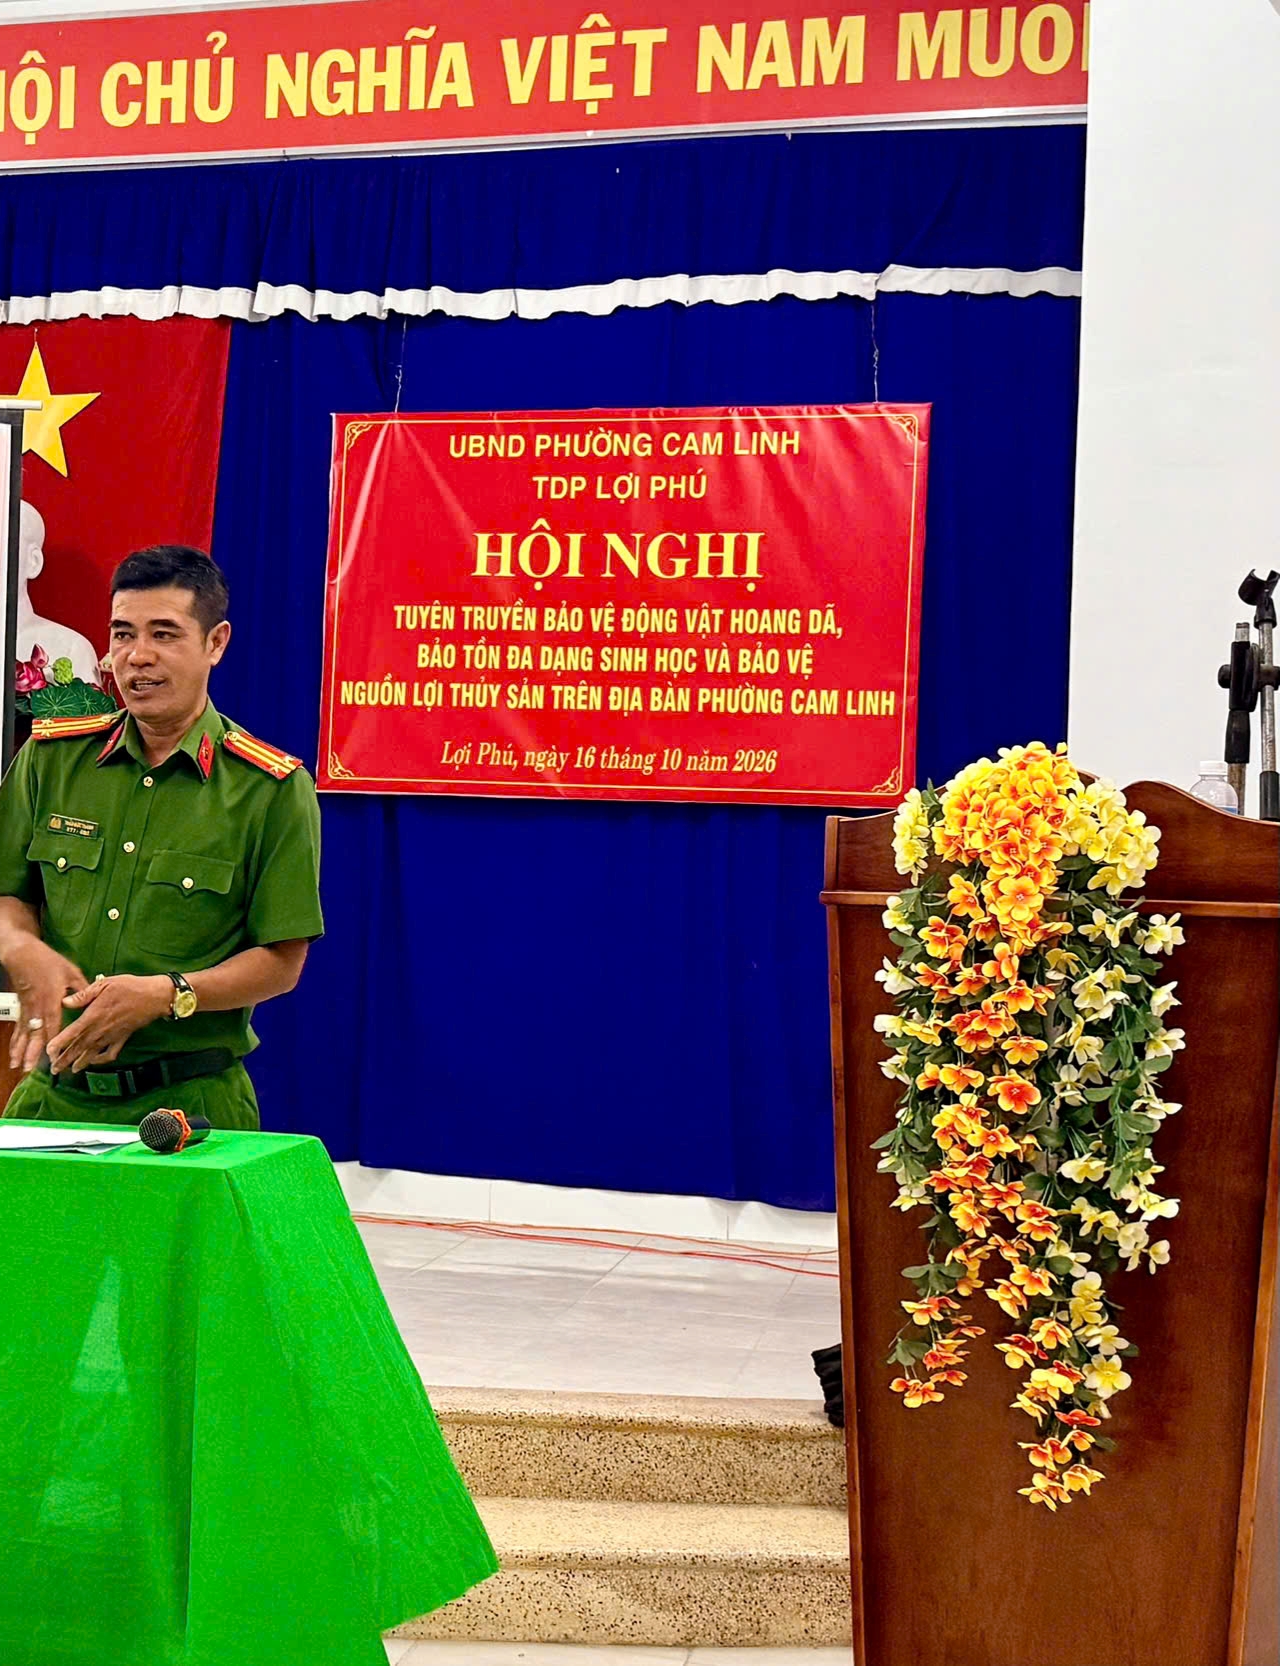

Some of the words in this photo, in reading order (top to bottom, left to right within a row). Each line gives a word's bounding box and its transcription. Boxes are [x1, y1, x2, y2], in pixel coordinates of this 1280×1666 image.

[100, 30, 235, 127] CHỦ
[264, 25, 475, 117] NGHĨA
[501, 12, 667, 115] VIỆT
[695, 14, 866, 93] NAM
[448, 434, 524, 459] UBND
[534, 429, 654, 457] PHƯỜNG
[662, 432, 724, 457] CAM
[734, 431, 800, 456] LINH
[533, 476, 587, 499] TDP
[596, 473, 641, 504] LỢI
[649, 467, 707, 499] PHÚ
[471, 518, 587, 591] HỘI
[601, 532, 765, 592] NGHỊ
[393, 599, 455, 630] TUYÊN
[462, 597, 537, 631] TRUYỀN
[544, 600, 583, 632] BẢO
[590, 601, 615, 638] VỆ
[621, 602, 677, 638] ĐỘNG
[685, 602, 724, 639] VẬT
[730, 609, 801, 634] HOANG
[808, 603, 843, 639] DÃ,
[416, 637, 456, 669] BẢO
[463, 635, 501, 670] TỒN
[506, 646, 533, 670] ĐA
[540, 646, 593, 676] DẠNG
[599, 647, 648, 672] SINH
[654, 647, 697, 678] HỌC
[704, 642, 731, 673] VÀ
[737, 641, 780, 674] BẢO
[787, 642, 814, 680] VỆ
[341, 673, 406, 706] NGUỒN
[413, 680, 444, 712] LỢI
[449, 676, 501, 708] THỦY
[506, 677, 545, 710] SẢN
[551, 680, 602, 711] TRÊN
[608, 687, 643, 717] ĐỊA
[649, 681, 691, 712] BÀN
[697, 682, 783, 714] PHƯỜNG
[790, 688, 838, 715] CAM
[846, 690, 895, 716] LINH
[440, 740, 472, 770] Lợi
[476, 742, 518, 771] Phú,
[522, 744, 569, 771] ngày
[573, 746, 595, 769] 16
[599, 745, 656, 776] tháng
[659, 747, 682, 771] 10
[685, 749, 729, 772] năm
[731, 749, 777, 774] 2026
